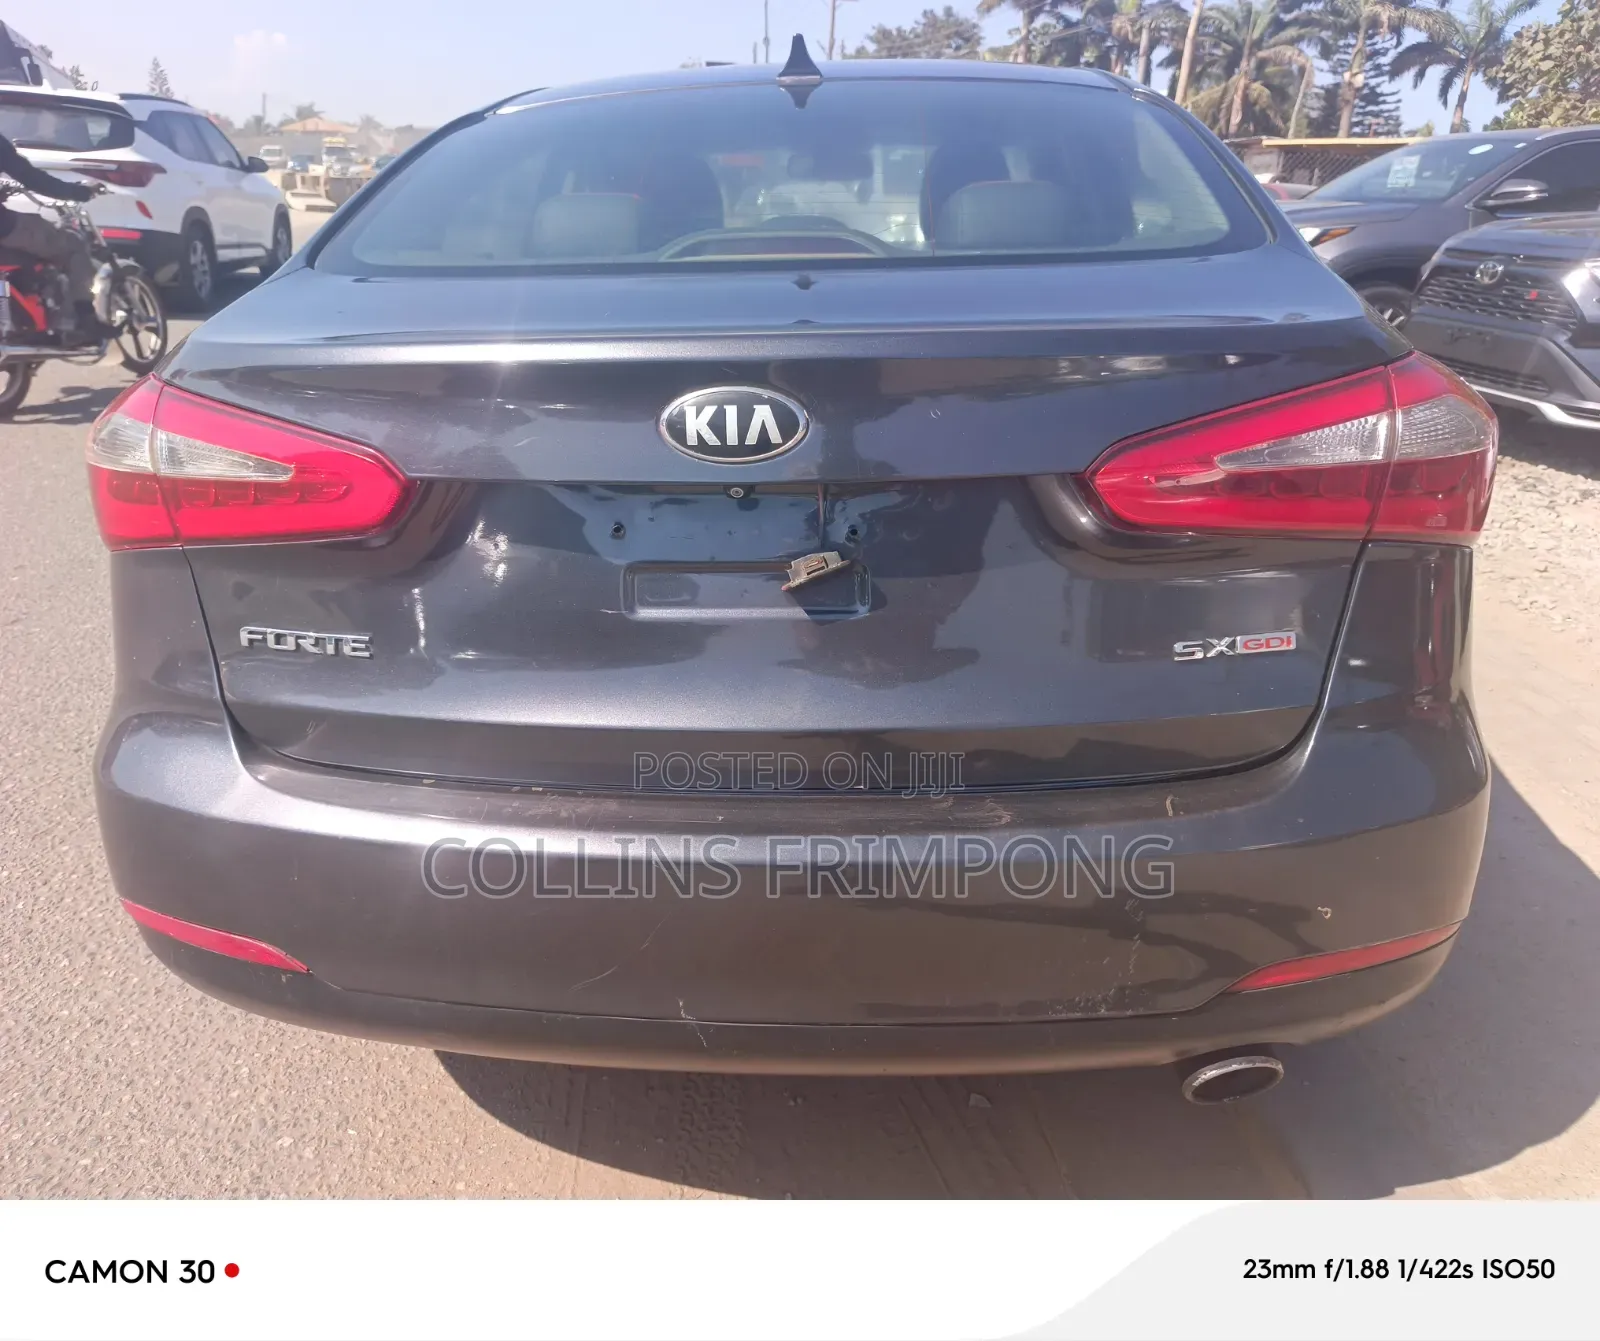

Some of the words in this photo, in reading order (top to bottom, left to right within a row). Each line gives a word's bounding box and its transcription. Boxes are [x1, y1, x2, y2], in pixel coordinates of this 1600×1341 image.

[684, 404, 783, 446] KIA
[239, 626, 371, 658] FORTE
[1173, 636, 1235, 661] SX
